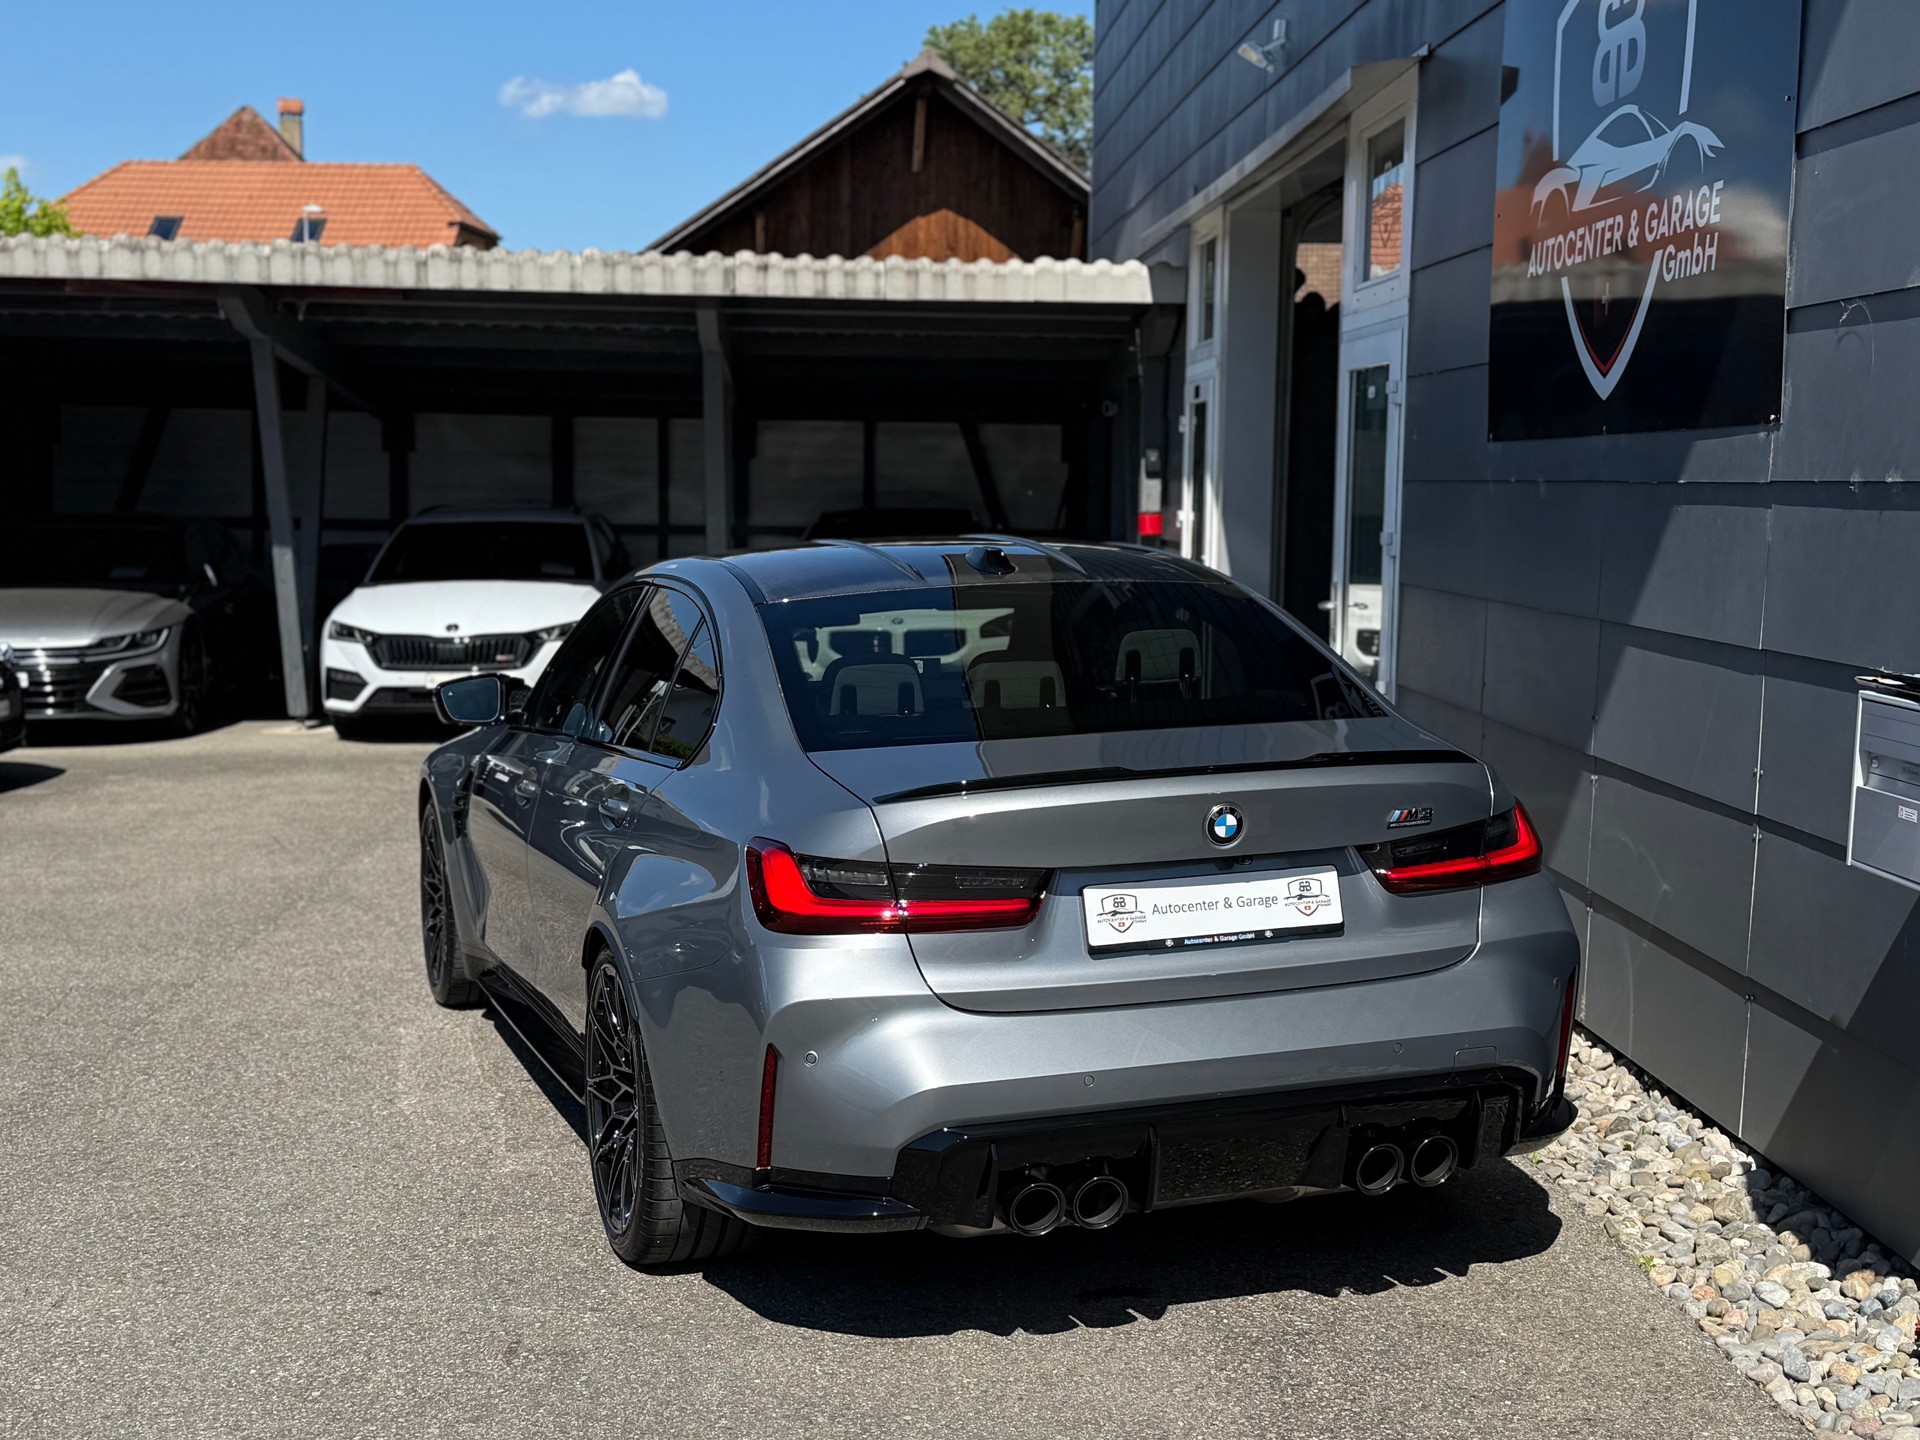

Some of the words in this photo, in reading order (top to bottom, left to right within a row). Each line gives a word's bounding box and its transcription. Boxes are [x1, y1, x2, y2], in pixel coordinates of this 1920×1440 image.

[1527, 214, 1624, 279] AUTOCENTER
[1627, 208, 1639, 249] &
[1644, 179, 1724, 243] GARAGE
[1662, 231, 1719, 282] GmbH
[1152, 900, 1219, 916] Autocenter
[1223, 896, 1233, 909] &
[1236, 896, 1278, 908] Garage
[1184, 937, 1213, 945] Autocenter
